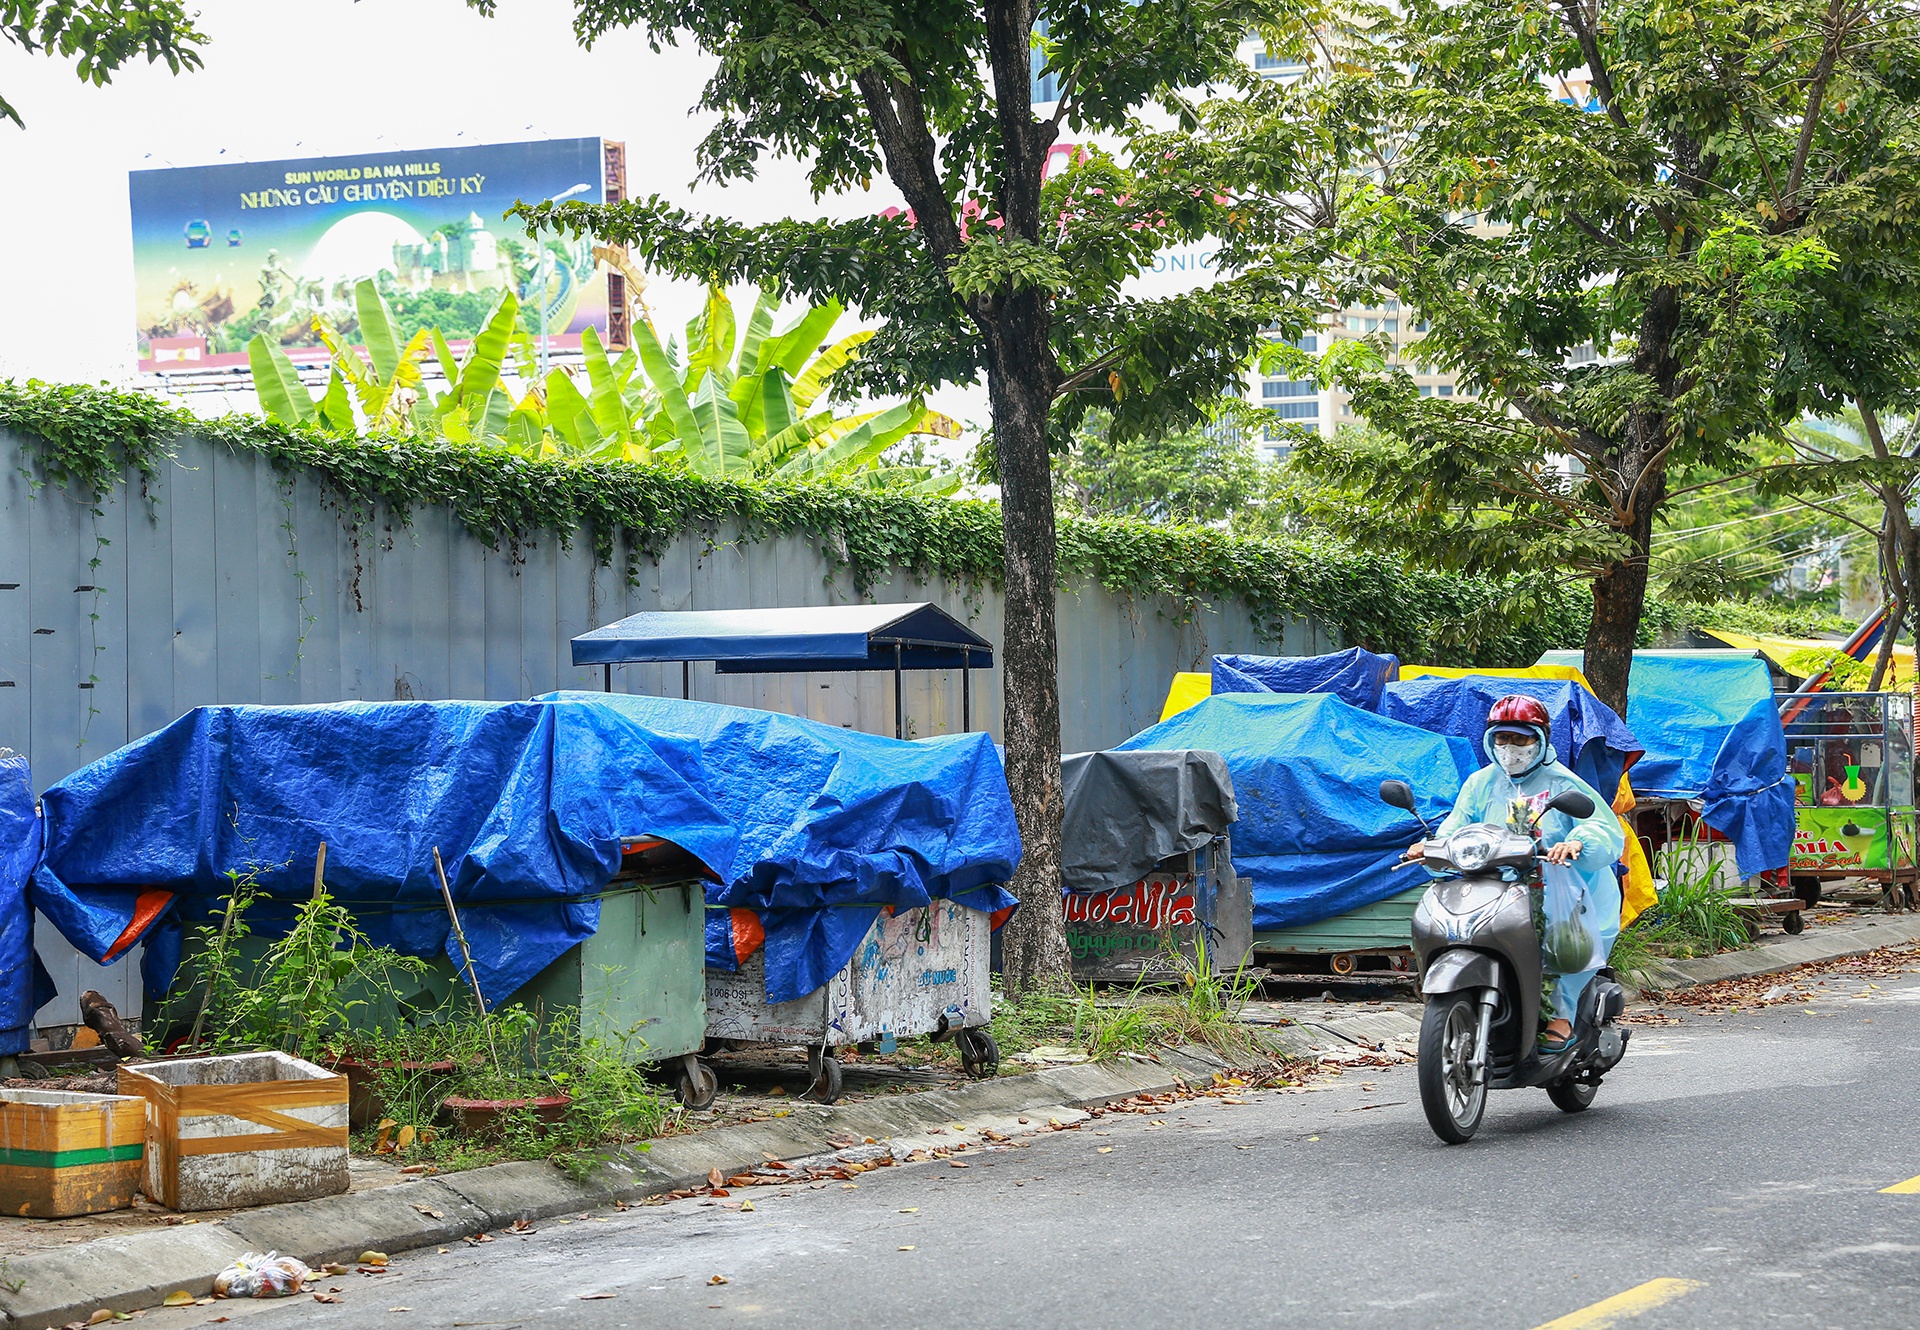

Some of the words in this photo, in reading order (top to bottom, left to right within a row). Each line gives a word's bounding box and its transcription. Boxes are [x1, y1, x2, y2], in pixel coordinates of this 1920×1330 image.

[284, 172, 312, 185] SUN
[313, 168, 361, 183] WORLD
[363, 166, 382, 179] BA
[383, 164, 403, 177] NA
[404, 162, 441, 176] HILLS
[304, 183, 339, 205] CÂU
[343, 179, 414, 202] CHUYỆN
[417, 176, 456, 199] DIỆU
[460, 172, 486, 194] KỲ
[1793, 838, 1848, 855] MÍA
